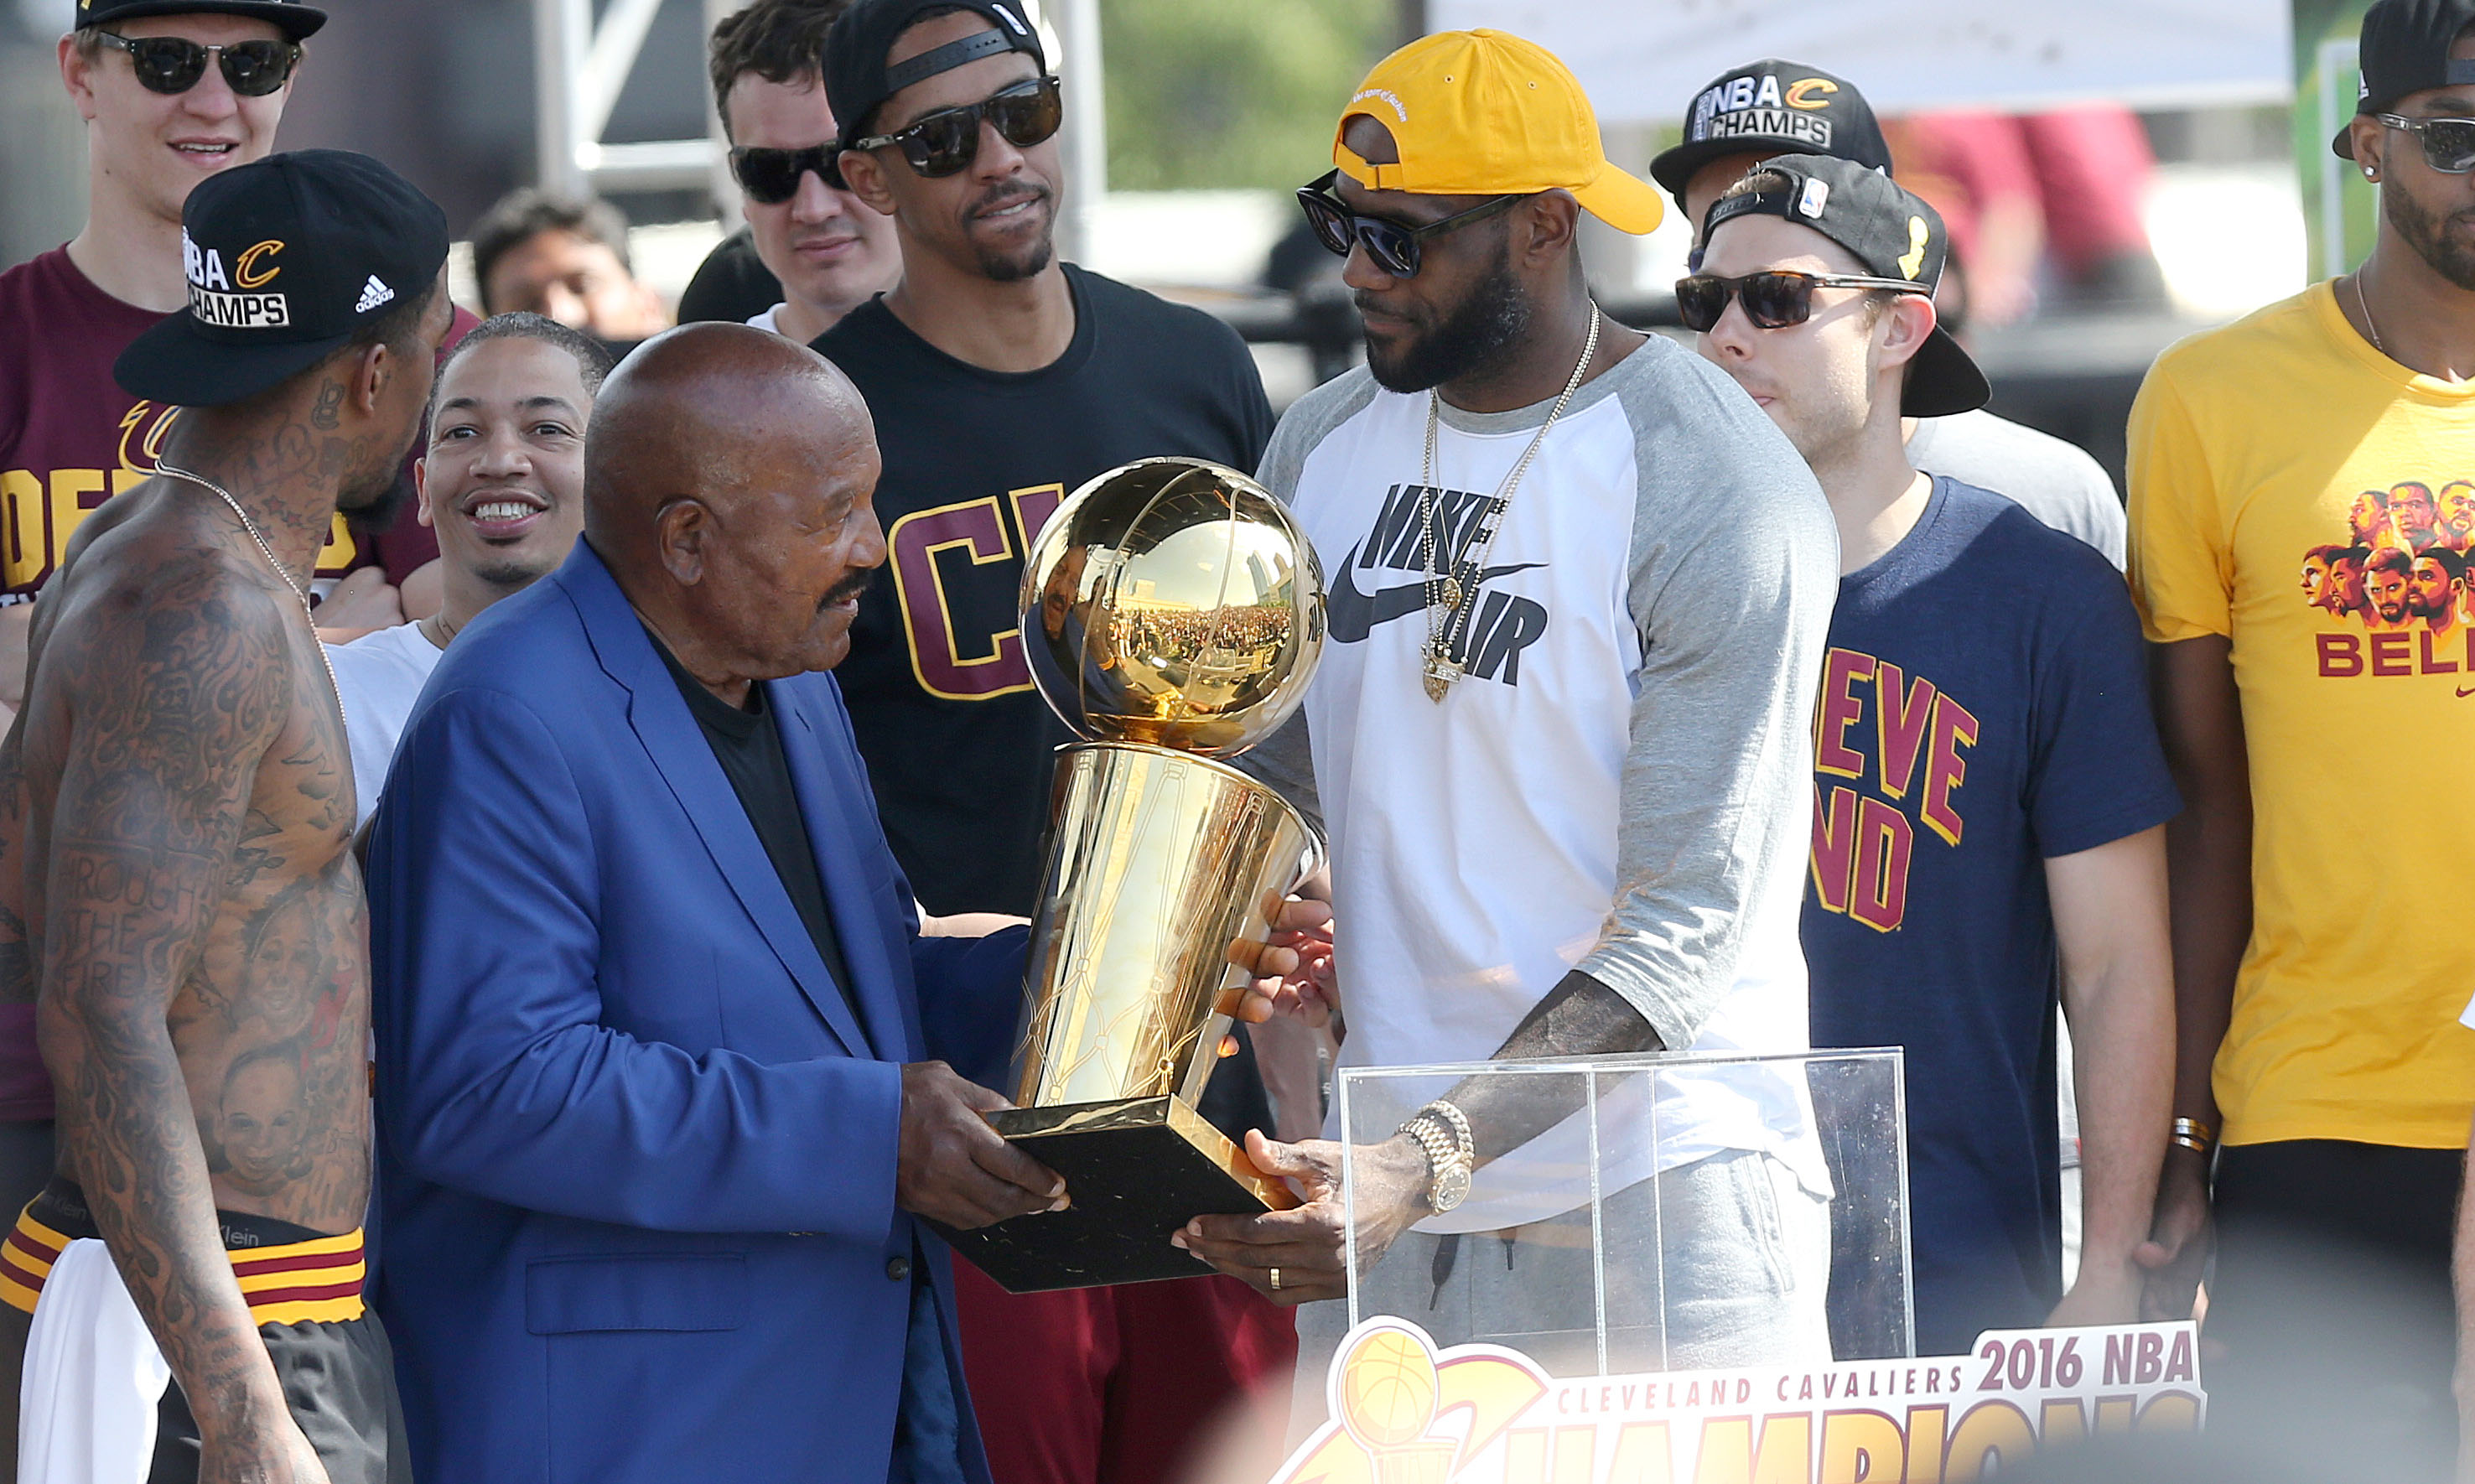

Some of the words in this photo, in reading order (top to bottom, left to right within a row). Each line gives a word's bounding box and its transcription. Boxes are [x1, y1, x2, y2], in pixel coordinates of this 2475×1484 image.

[1710, 74, 1782, 117] NBA
[1710, 110, 1828, 145] CHAMPS
[355, 288, 395, 314] adidas
[1358, 483, 1509, 576] NIKE
[887, 483, 1065, 701] C
[1812, 646, 1979, 848] EVE
[1557, 1378, 1751, 1414] CLEVELAND
[1777, 1366, 1961, 1401] CAVALIERS
[1976, 1336, 2083, 1393] 2016
[2103, 1331, 2195, 1385] NBA
